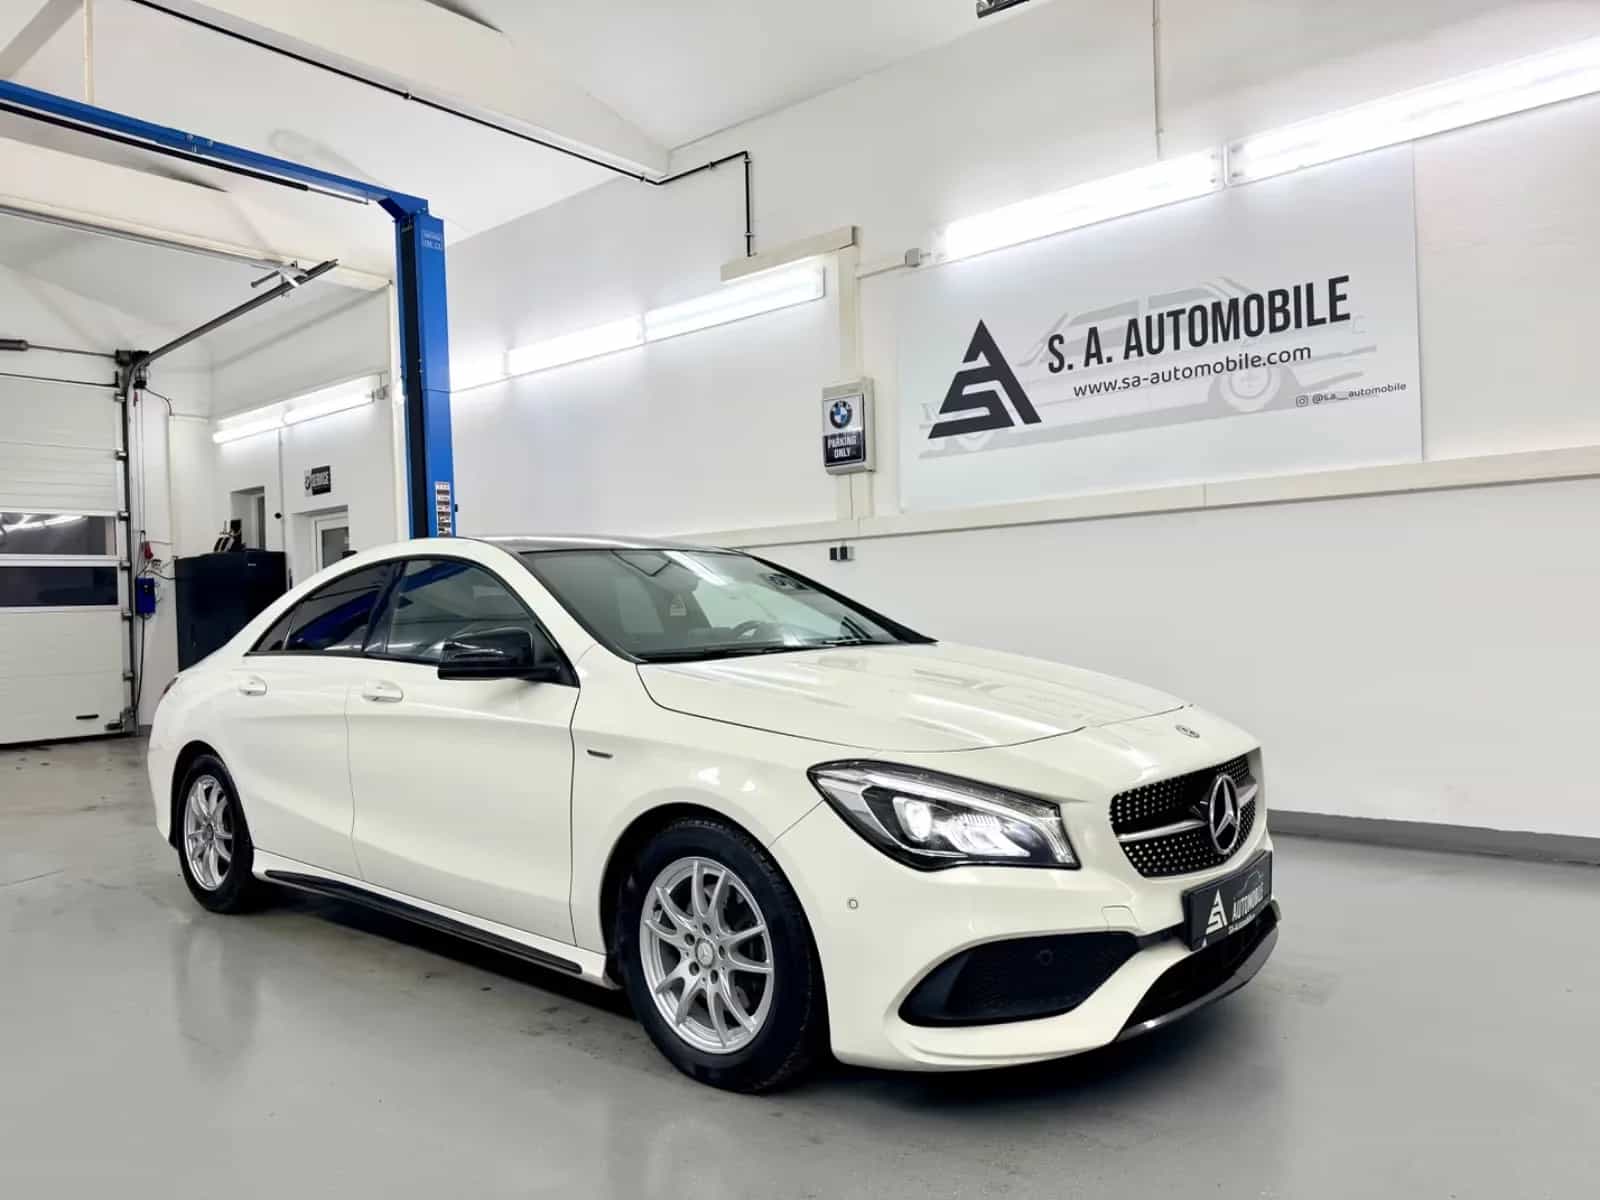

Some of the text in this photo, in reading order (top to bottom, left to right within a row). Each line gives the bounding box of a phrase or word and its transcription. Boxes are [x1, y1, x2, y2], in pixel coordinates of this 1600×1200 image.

[1047, 275, 1352, 374] S. A. AUTOMOBILE
[1073, 346, 1312, 397] www.sa-automobile.com
[834, 447, 851, 459] ONLY
